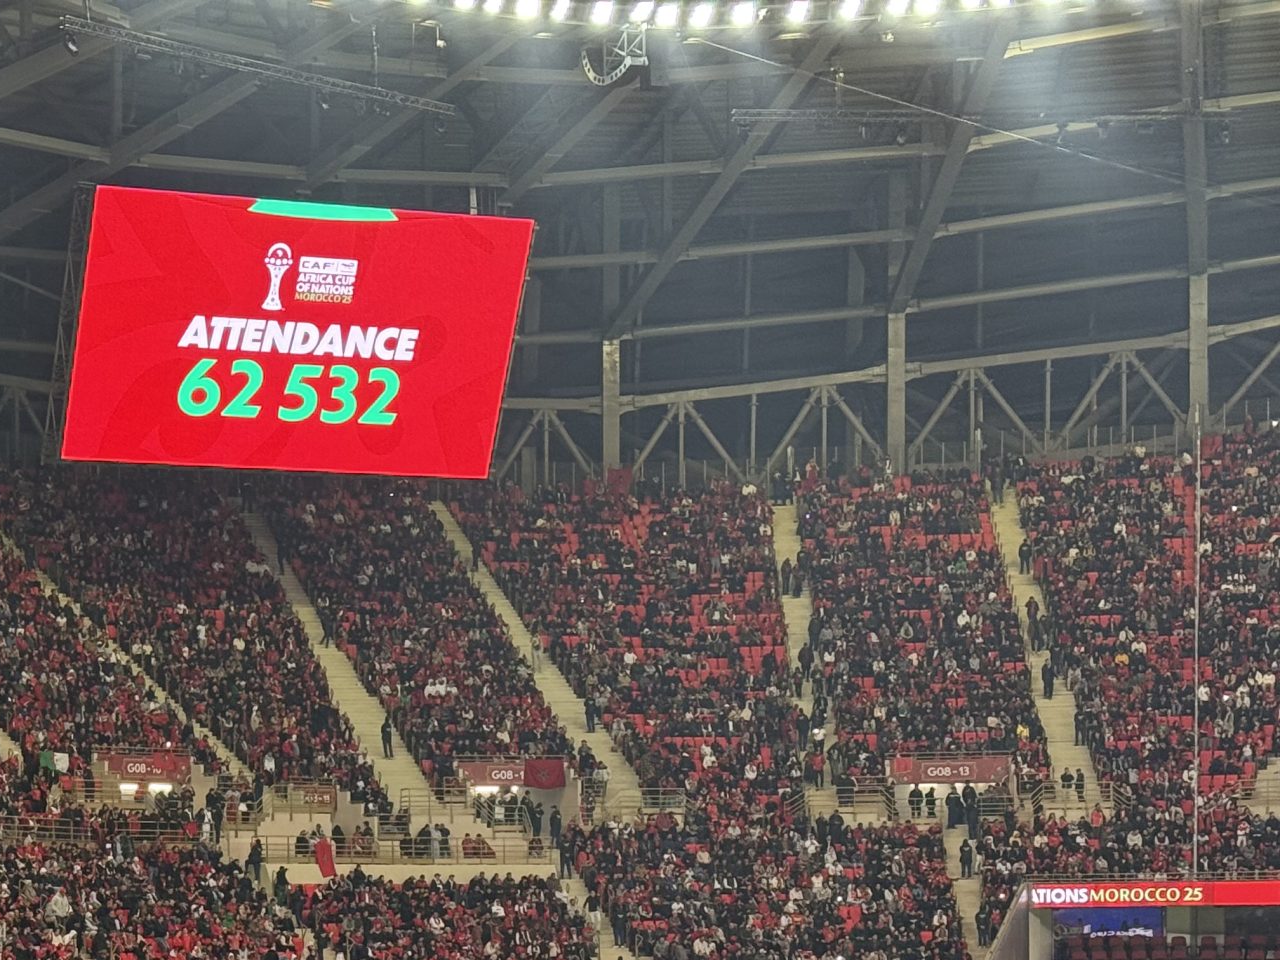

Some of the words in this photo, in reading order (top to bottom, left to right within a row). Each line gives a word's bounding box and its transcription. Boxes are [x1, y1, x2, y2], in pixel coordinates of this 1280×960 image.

[297, 272, 334, 284] AFRICA
[335, 275, 356, 286] CUP
[296, 282, 311, 293] OF
[311, 284, 355, 295] NATIONS
[294, 292, 341, 303] MOROCCO
[342, 295, 352, 304] 25
[177, 314, 420, 362] ATTENDANCE
[177, 357, 265, 419] 62
[277, 364, 401, 426] 532
[1089, 887, 1180, 903] MOROCCO
[1183, 887, 1203, 901] 25
